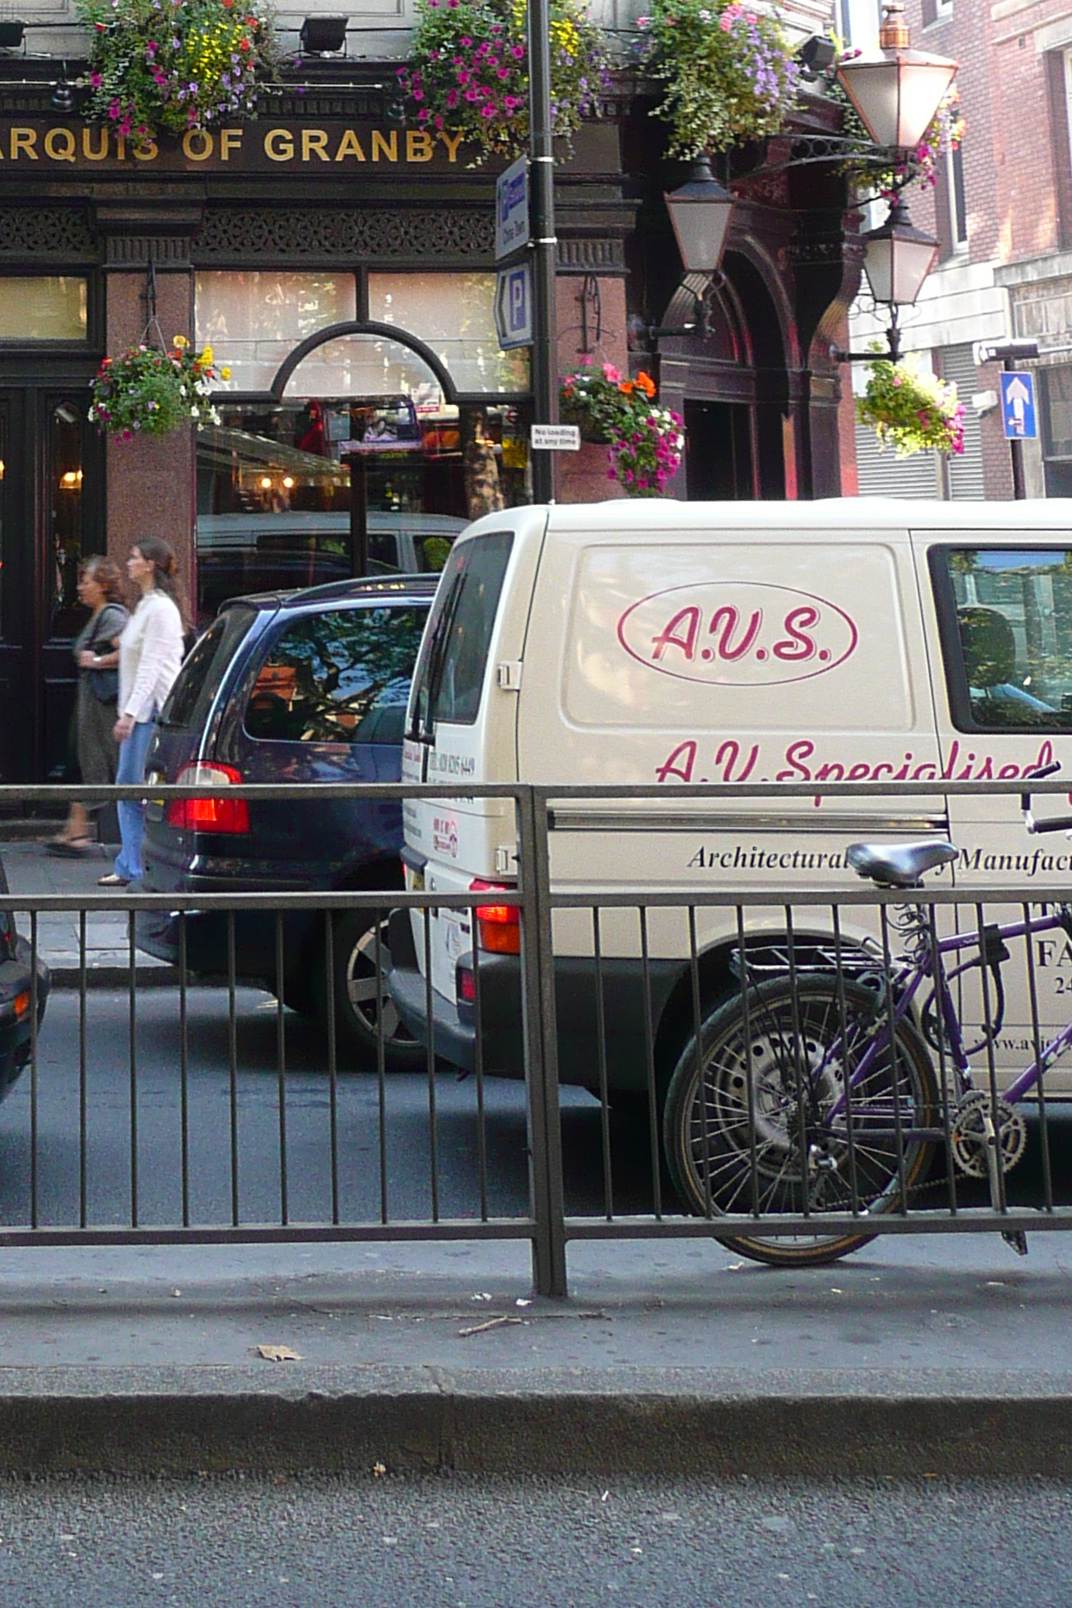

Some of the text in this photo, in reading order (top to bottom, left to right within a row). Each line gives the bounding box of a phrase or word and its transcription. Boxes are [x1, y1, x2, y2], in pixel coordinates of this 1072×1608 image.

[181, 128, 244, 161] OF
[264, 128, 466, 163] GRANBY
[651, 604, 832, 663] A.V.S.
[687, 846, 849, 870] Architectural
